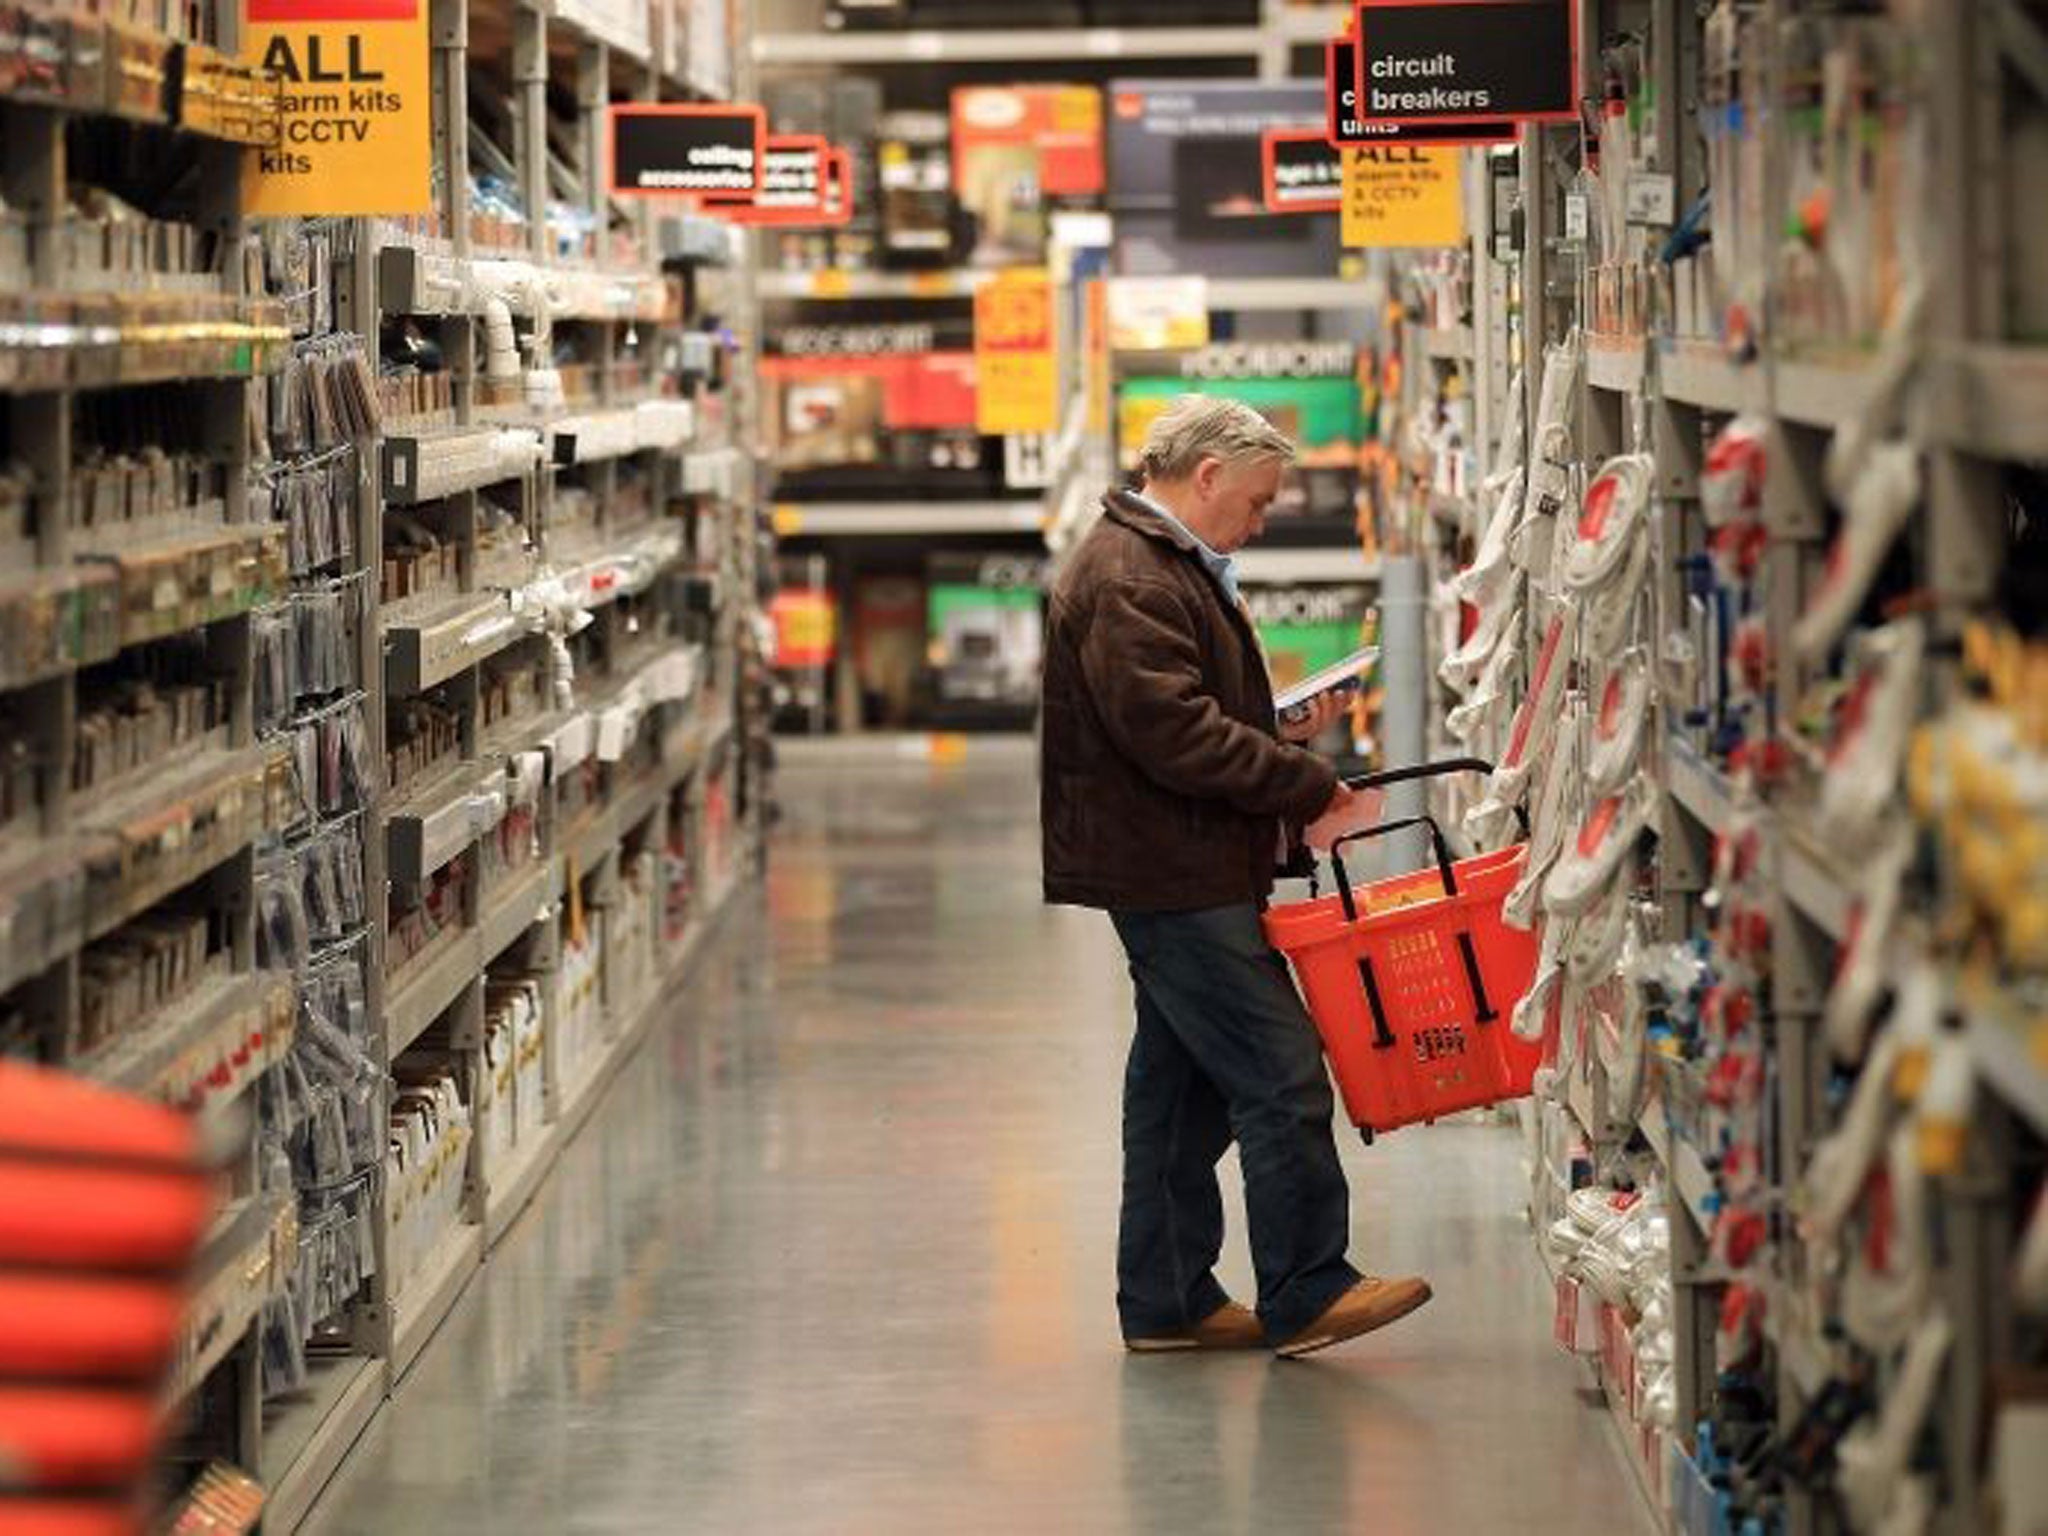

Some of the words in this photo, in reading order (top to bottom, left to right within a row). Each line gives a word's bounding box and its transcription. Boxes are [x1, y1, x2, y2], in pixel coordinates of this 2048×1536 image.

[262, 34, 384, 83] ALL
[1371, 54, 1455, 78] circuit
[272, 95, 339, 113] arm
[349, 90, 402, 113] kits
[1372, 87, 1490, 111] breakers
[288, 119, 370, 143] CCTV
[260, 152, 312, 175] kits
